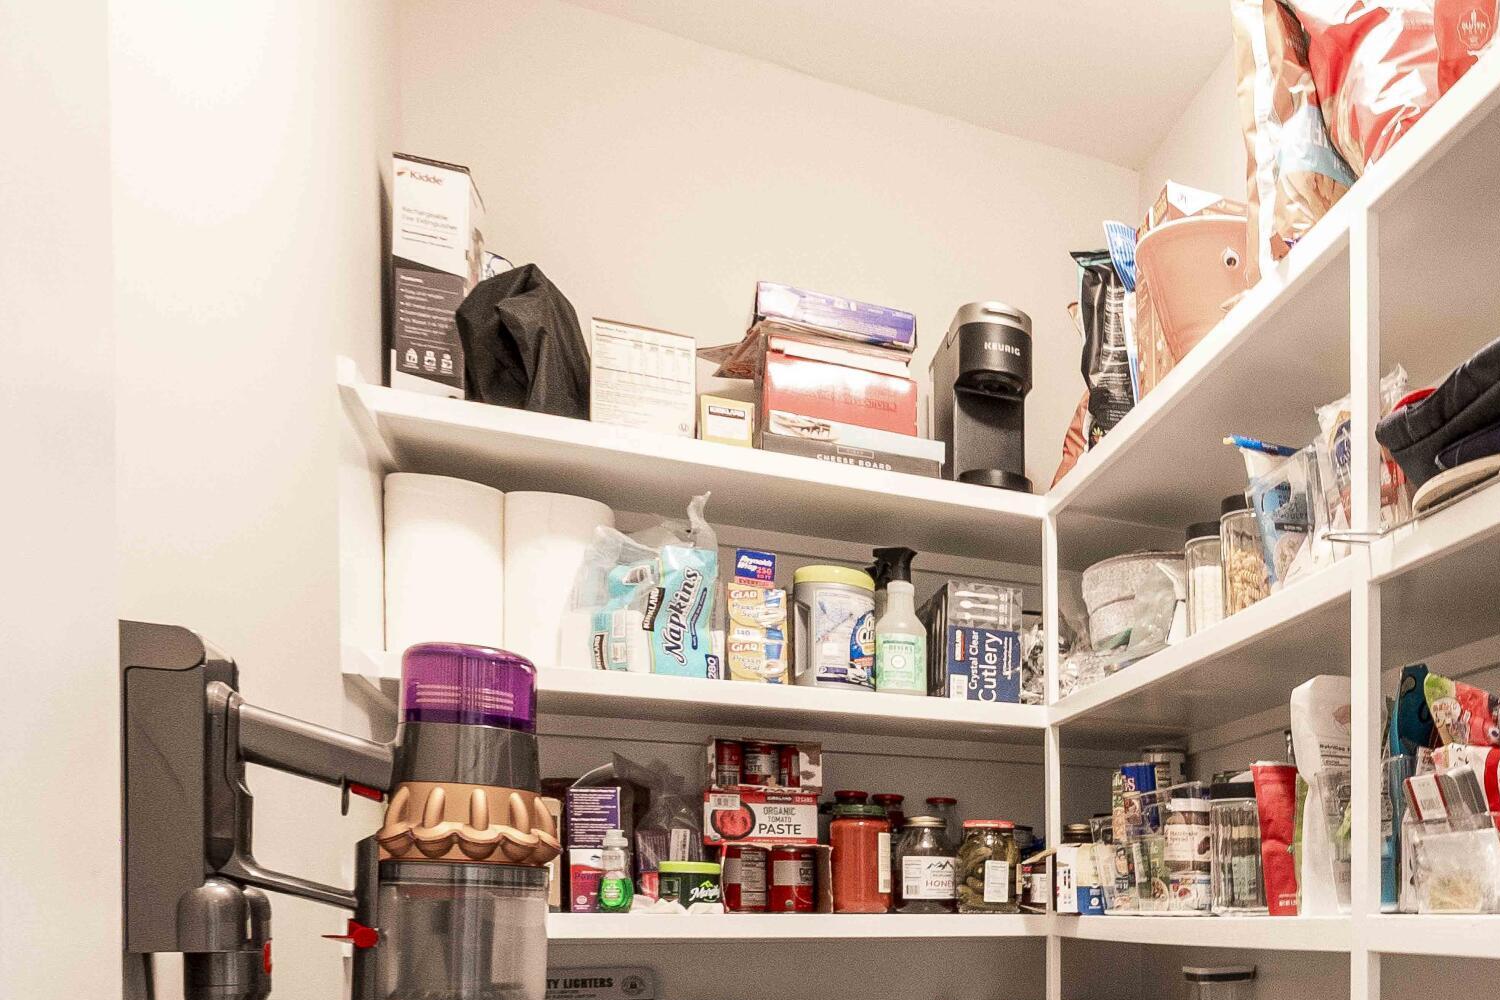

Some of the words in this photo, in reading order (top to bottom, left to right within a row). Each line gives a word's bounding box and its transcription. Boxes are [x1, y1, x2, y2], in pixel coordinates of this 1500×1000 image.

[409, 170, 442, 186] Kidde
[984, 341, 1021, 356] KEURIG
[730, 590, 758, 599] GLAD
[643, 587, 661, 630] KIRKLAND
[663, 568, 701, 664] Napkins
[968, 631, 980, 653] Clear
[707, 657, 718, 680] 280
[968, 656, 980, 690] Crystal
[978, 632, 1003, 702] Cutlery
[763, 806, 796, 815] ORGANIC
[758, 823, 802, 835] PASTE
[925, 879, 955, 887] HONE
[563, 978, 613, 989] LIGHTERS
